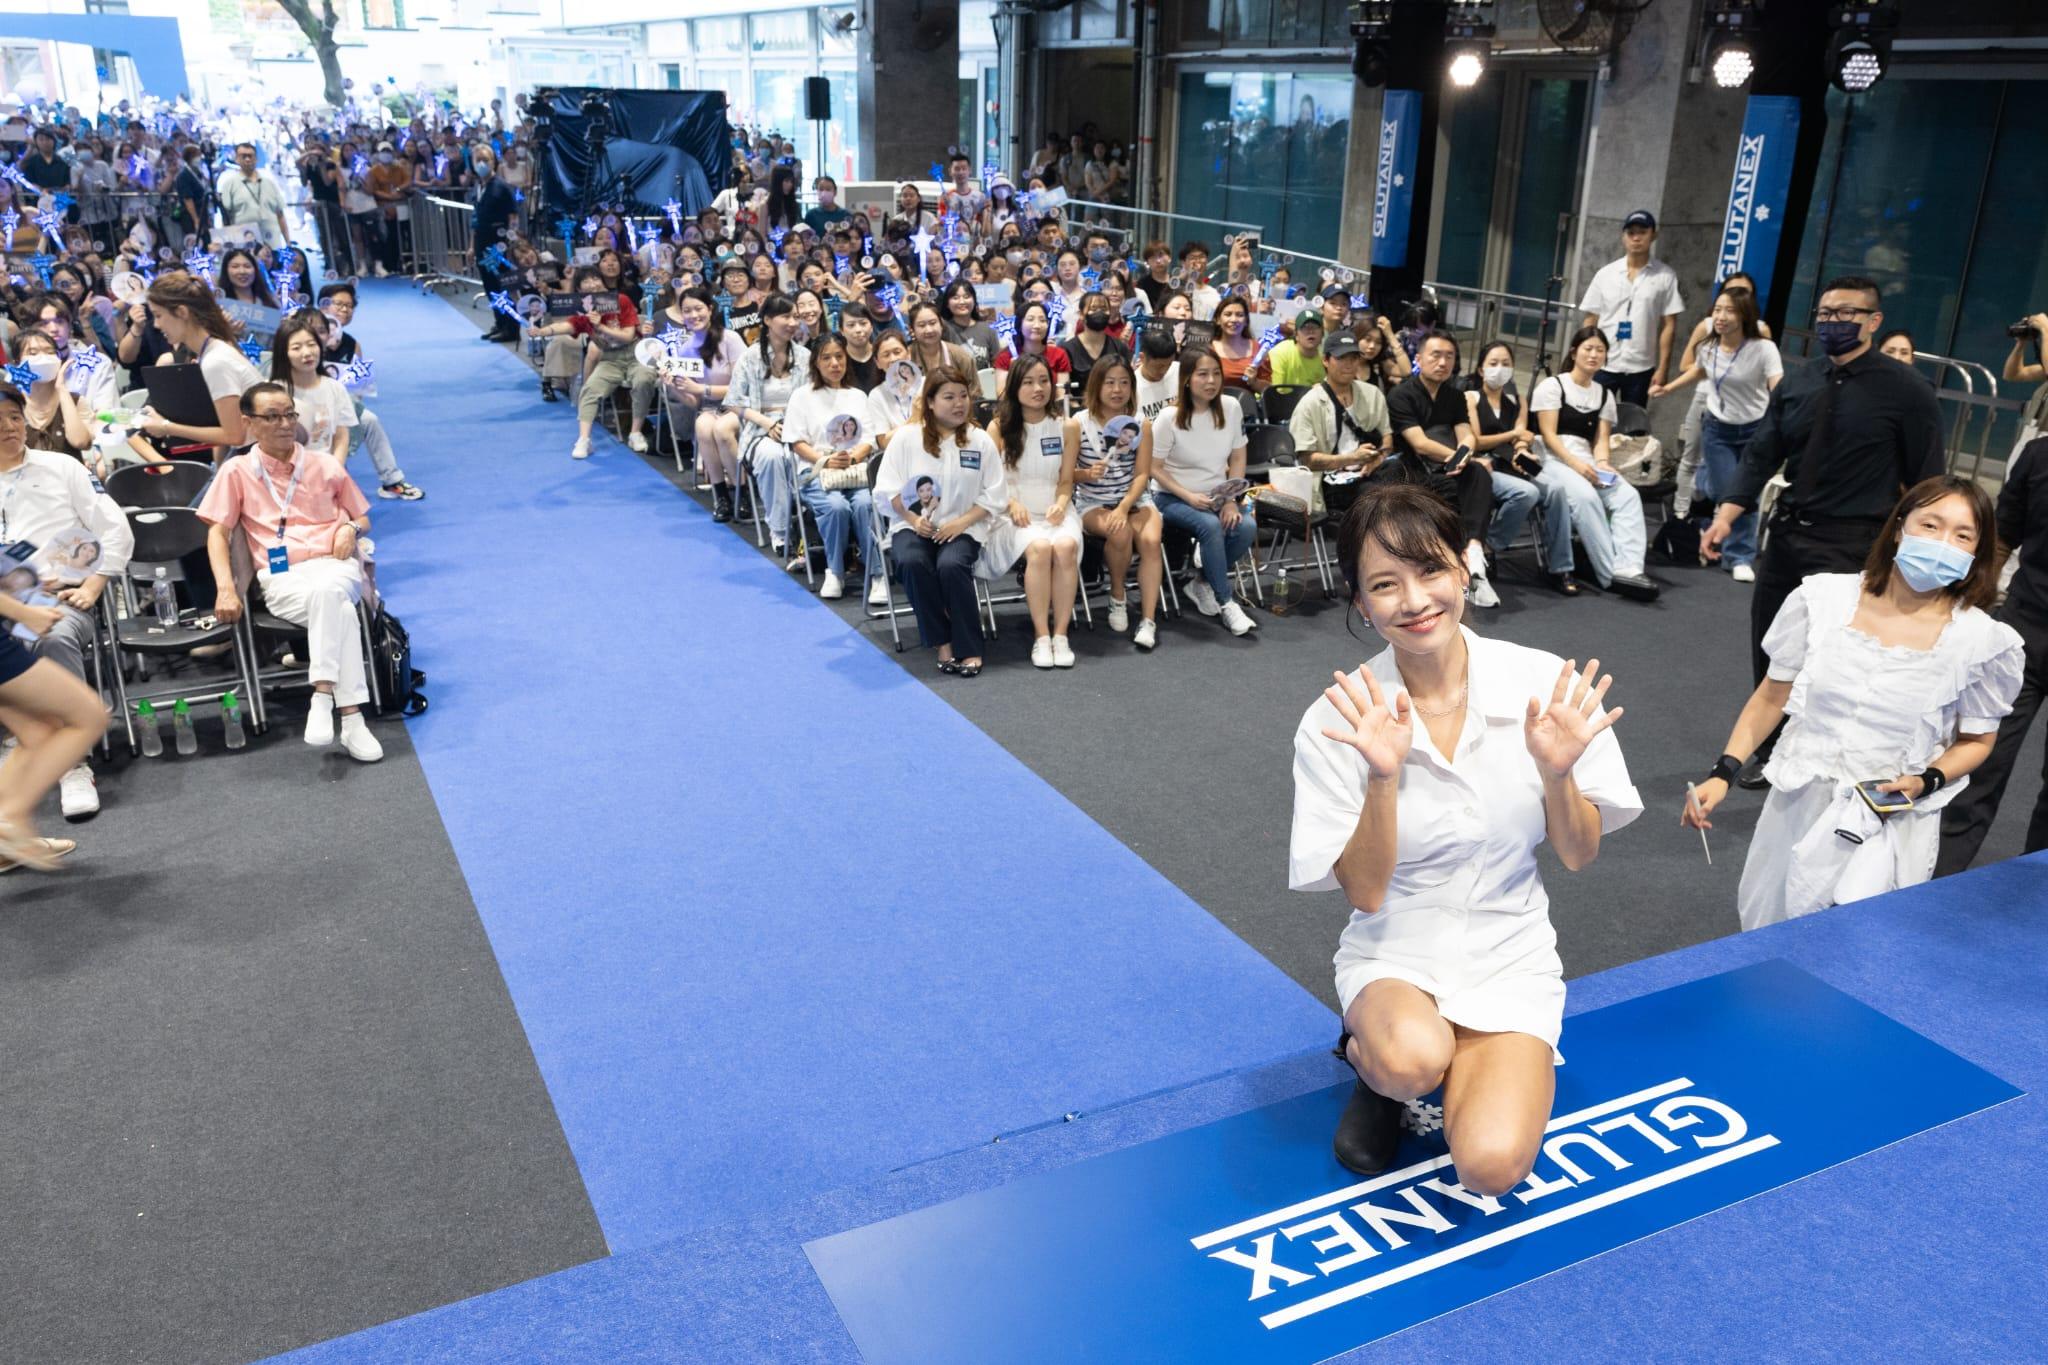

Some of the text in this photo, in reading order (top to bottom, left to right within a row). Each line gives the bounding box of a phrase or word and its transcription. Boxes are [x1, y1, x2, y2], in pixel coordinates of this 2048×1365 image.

[1373, 120, 1396, 238] GLUTANEX
[1716, 134, 1761, 284] GLUTANEX
[664, 359, 701, 372] 송지효
[1207, 1095, 1749, 1302] GLUTANEX
